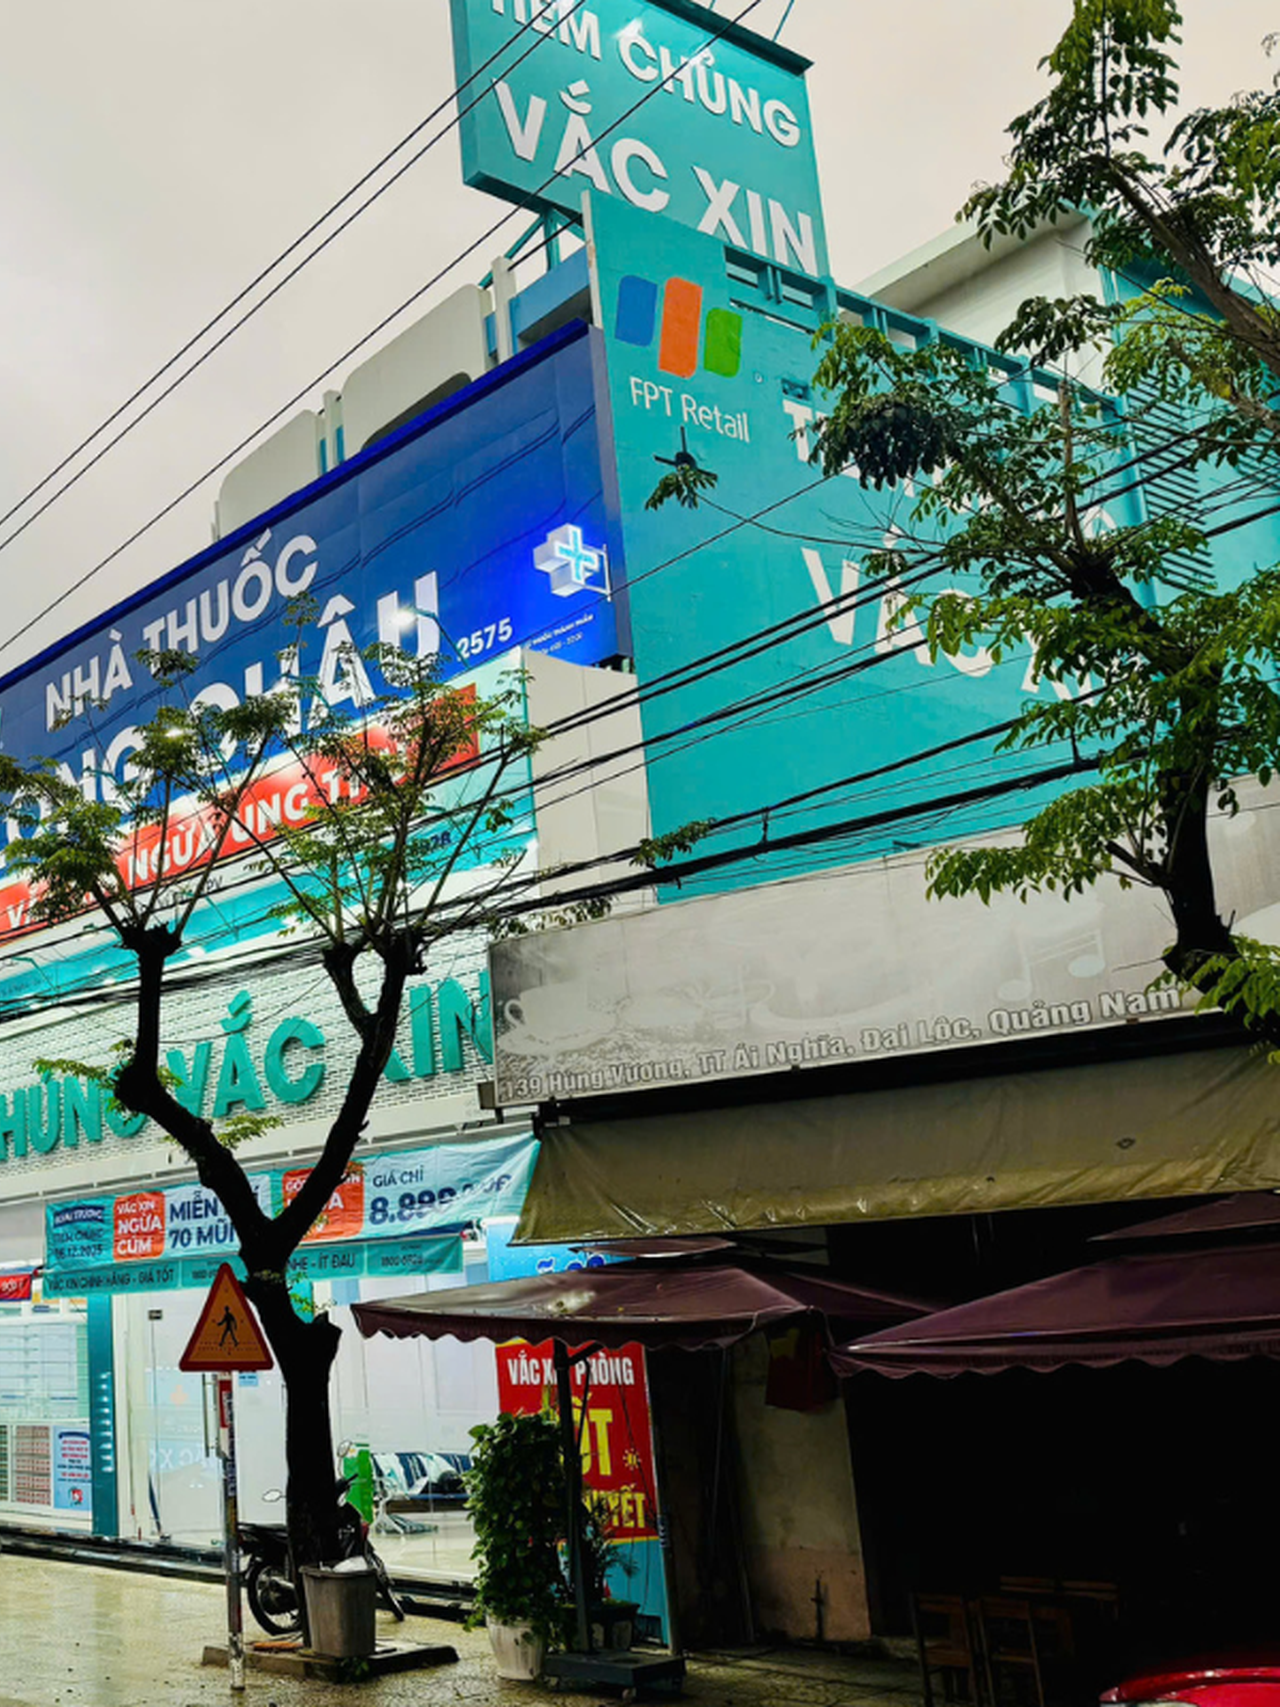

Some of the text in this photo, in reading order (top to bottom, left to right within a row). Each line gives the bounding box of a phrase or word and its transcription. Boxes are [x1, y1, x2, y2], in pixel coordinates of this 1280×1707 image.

[618, 32, 801, 148] CHỦNG
[491, 78, 820, 277] VẮC XIN
[629, 375, 751, 444] FPT Retail
[46, 528, 318, 732] NHÀ THUỐC
[456, 617, 513, 662] 2575
[166, 990, 326, 1118] VẮC
[360, 971, 494, 1085] IN
[698, 1050, 726, 1075] TT
[860, 1023, 909, 1053] Đại
[988, 999, 1093, 1036] Quảng
[1099, 987, 1183, 1019] Nam
[285, 1180, 306, 1194] GÓ
[373, 1170, 397, 1188] GIÁ
[117, 1213, 163, 1234] NGỪA
[170, 1190, 218, 1222] MIỄN
[117, 1234, 153, 1256] CÚM
[169, 1229, 191, 1249] 70
[507, 1350, 540, 1386] VẮC
[575, 1351, 635, 1386] PHÒNG
